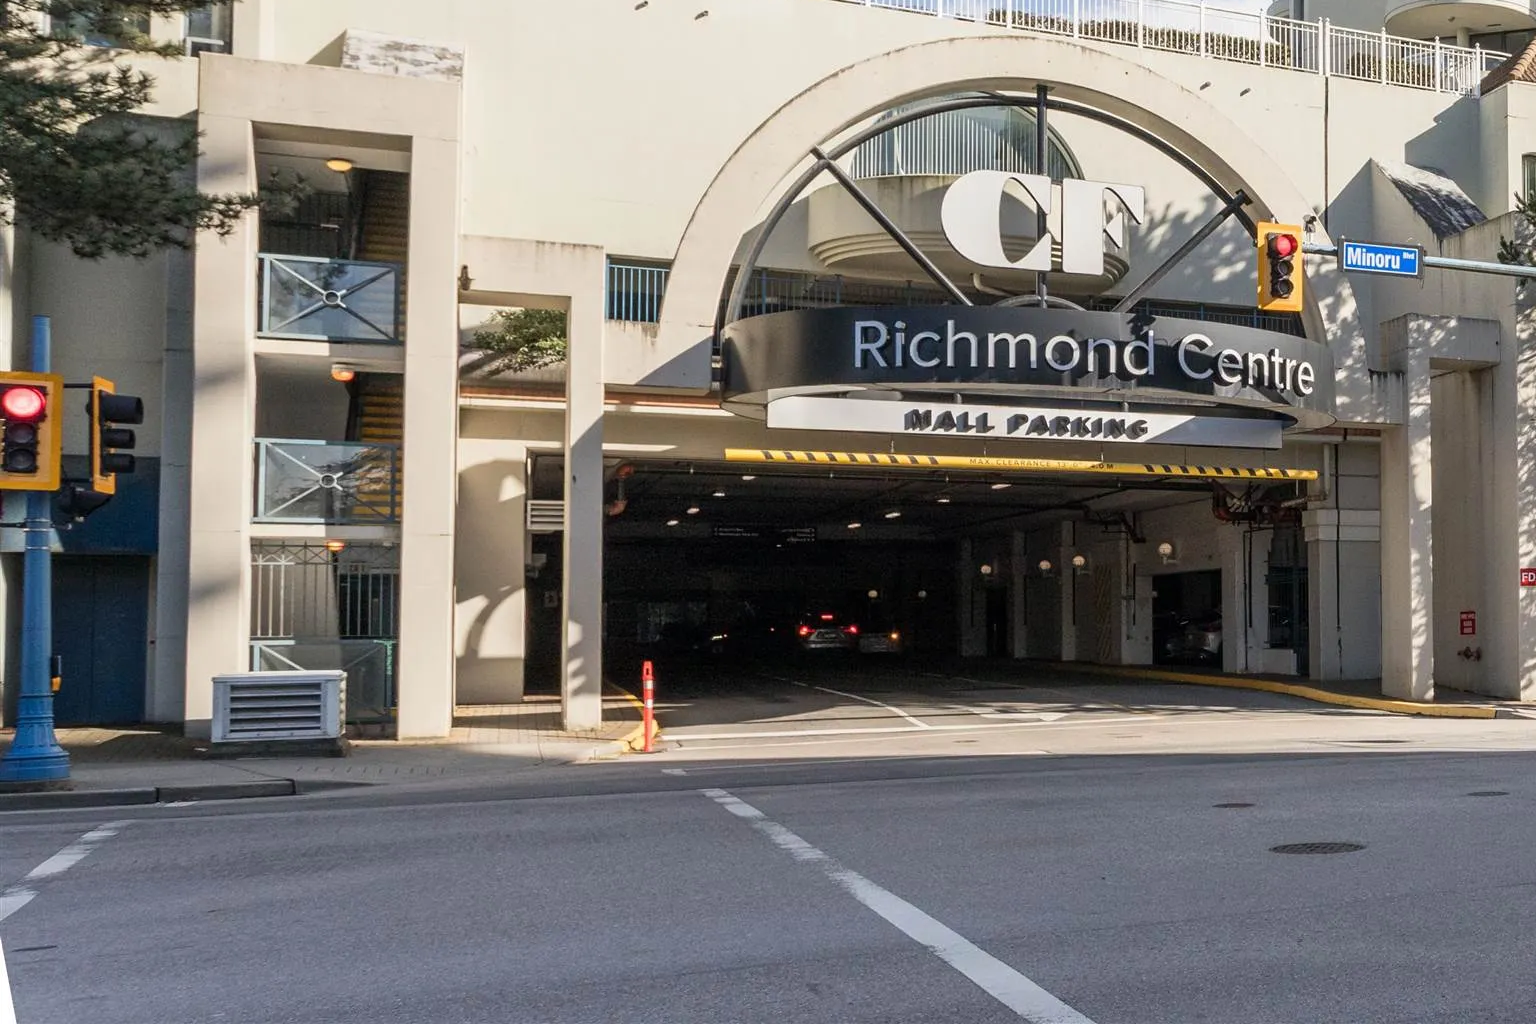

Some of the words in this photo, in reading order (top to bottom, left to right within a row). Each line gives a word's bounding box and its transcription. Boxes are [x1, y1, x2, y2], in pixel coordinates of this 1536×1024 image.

[941, 170, 1145, 275] CF
[1347, 246, 1400, 269] Minoru
[854, 320, 1155, 375] Richmond
[1177, 333, 1316, 396] Centre
[903, 409, 995, 433] MALL
[1006, 413, 1149, 441] PARKING
[996, 459, 1050, 469] CLEARANCE
